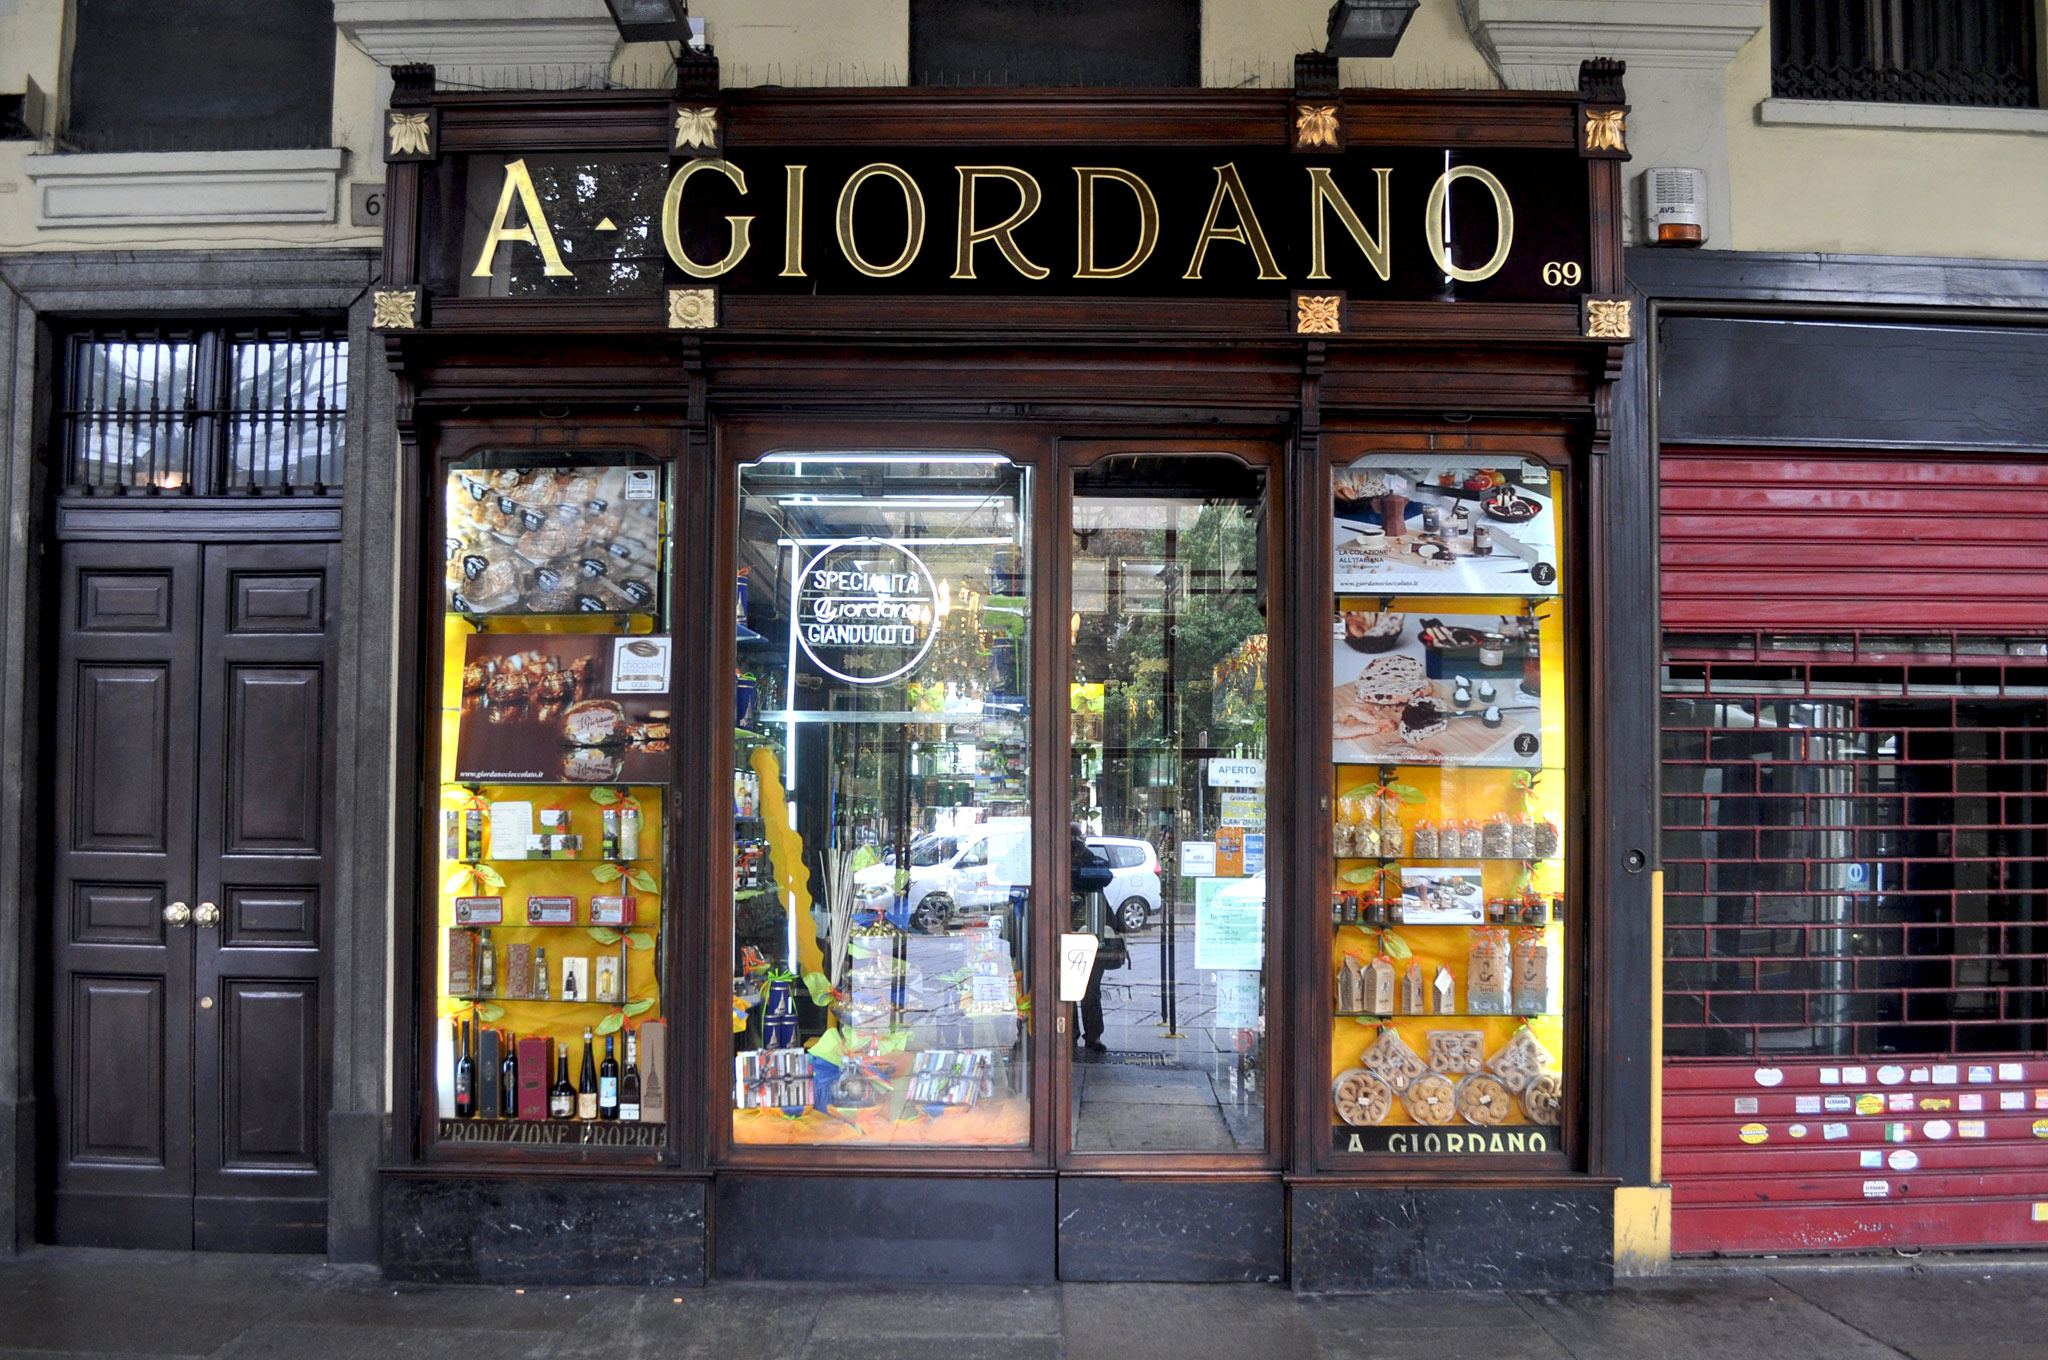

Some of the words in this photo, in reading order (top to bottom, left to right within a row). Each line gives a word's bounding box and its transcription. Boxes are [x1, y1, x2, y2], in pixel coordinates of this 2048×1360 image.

[366, 193, 386, 216] 6
[471, 158, 574, 278] A
[661, 157, 1514, 283] GIORDANO
[1542, 260, 1582, 287] 69
[460, 770, 544, 779] www.giordanocioccolato.it
[1218, 765, 1257, 775] APERTO
[1347, 1133, 1364, 1152] A
[1388, 1132, 1547, 1153] GIORDANO
